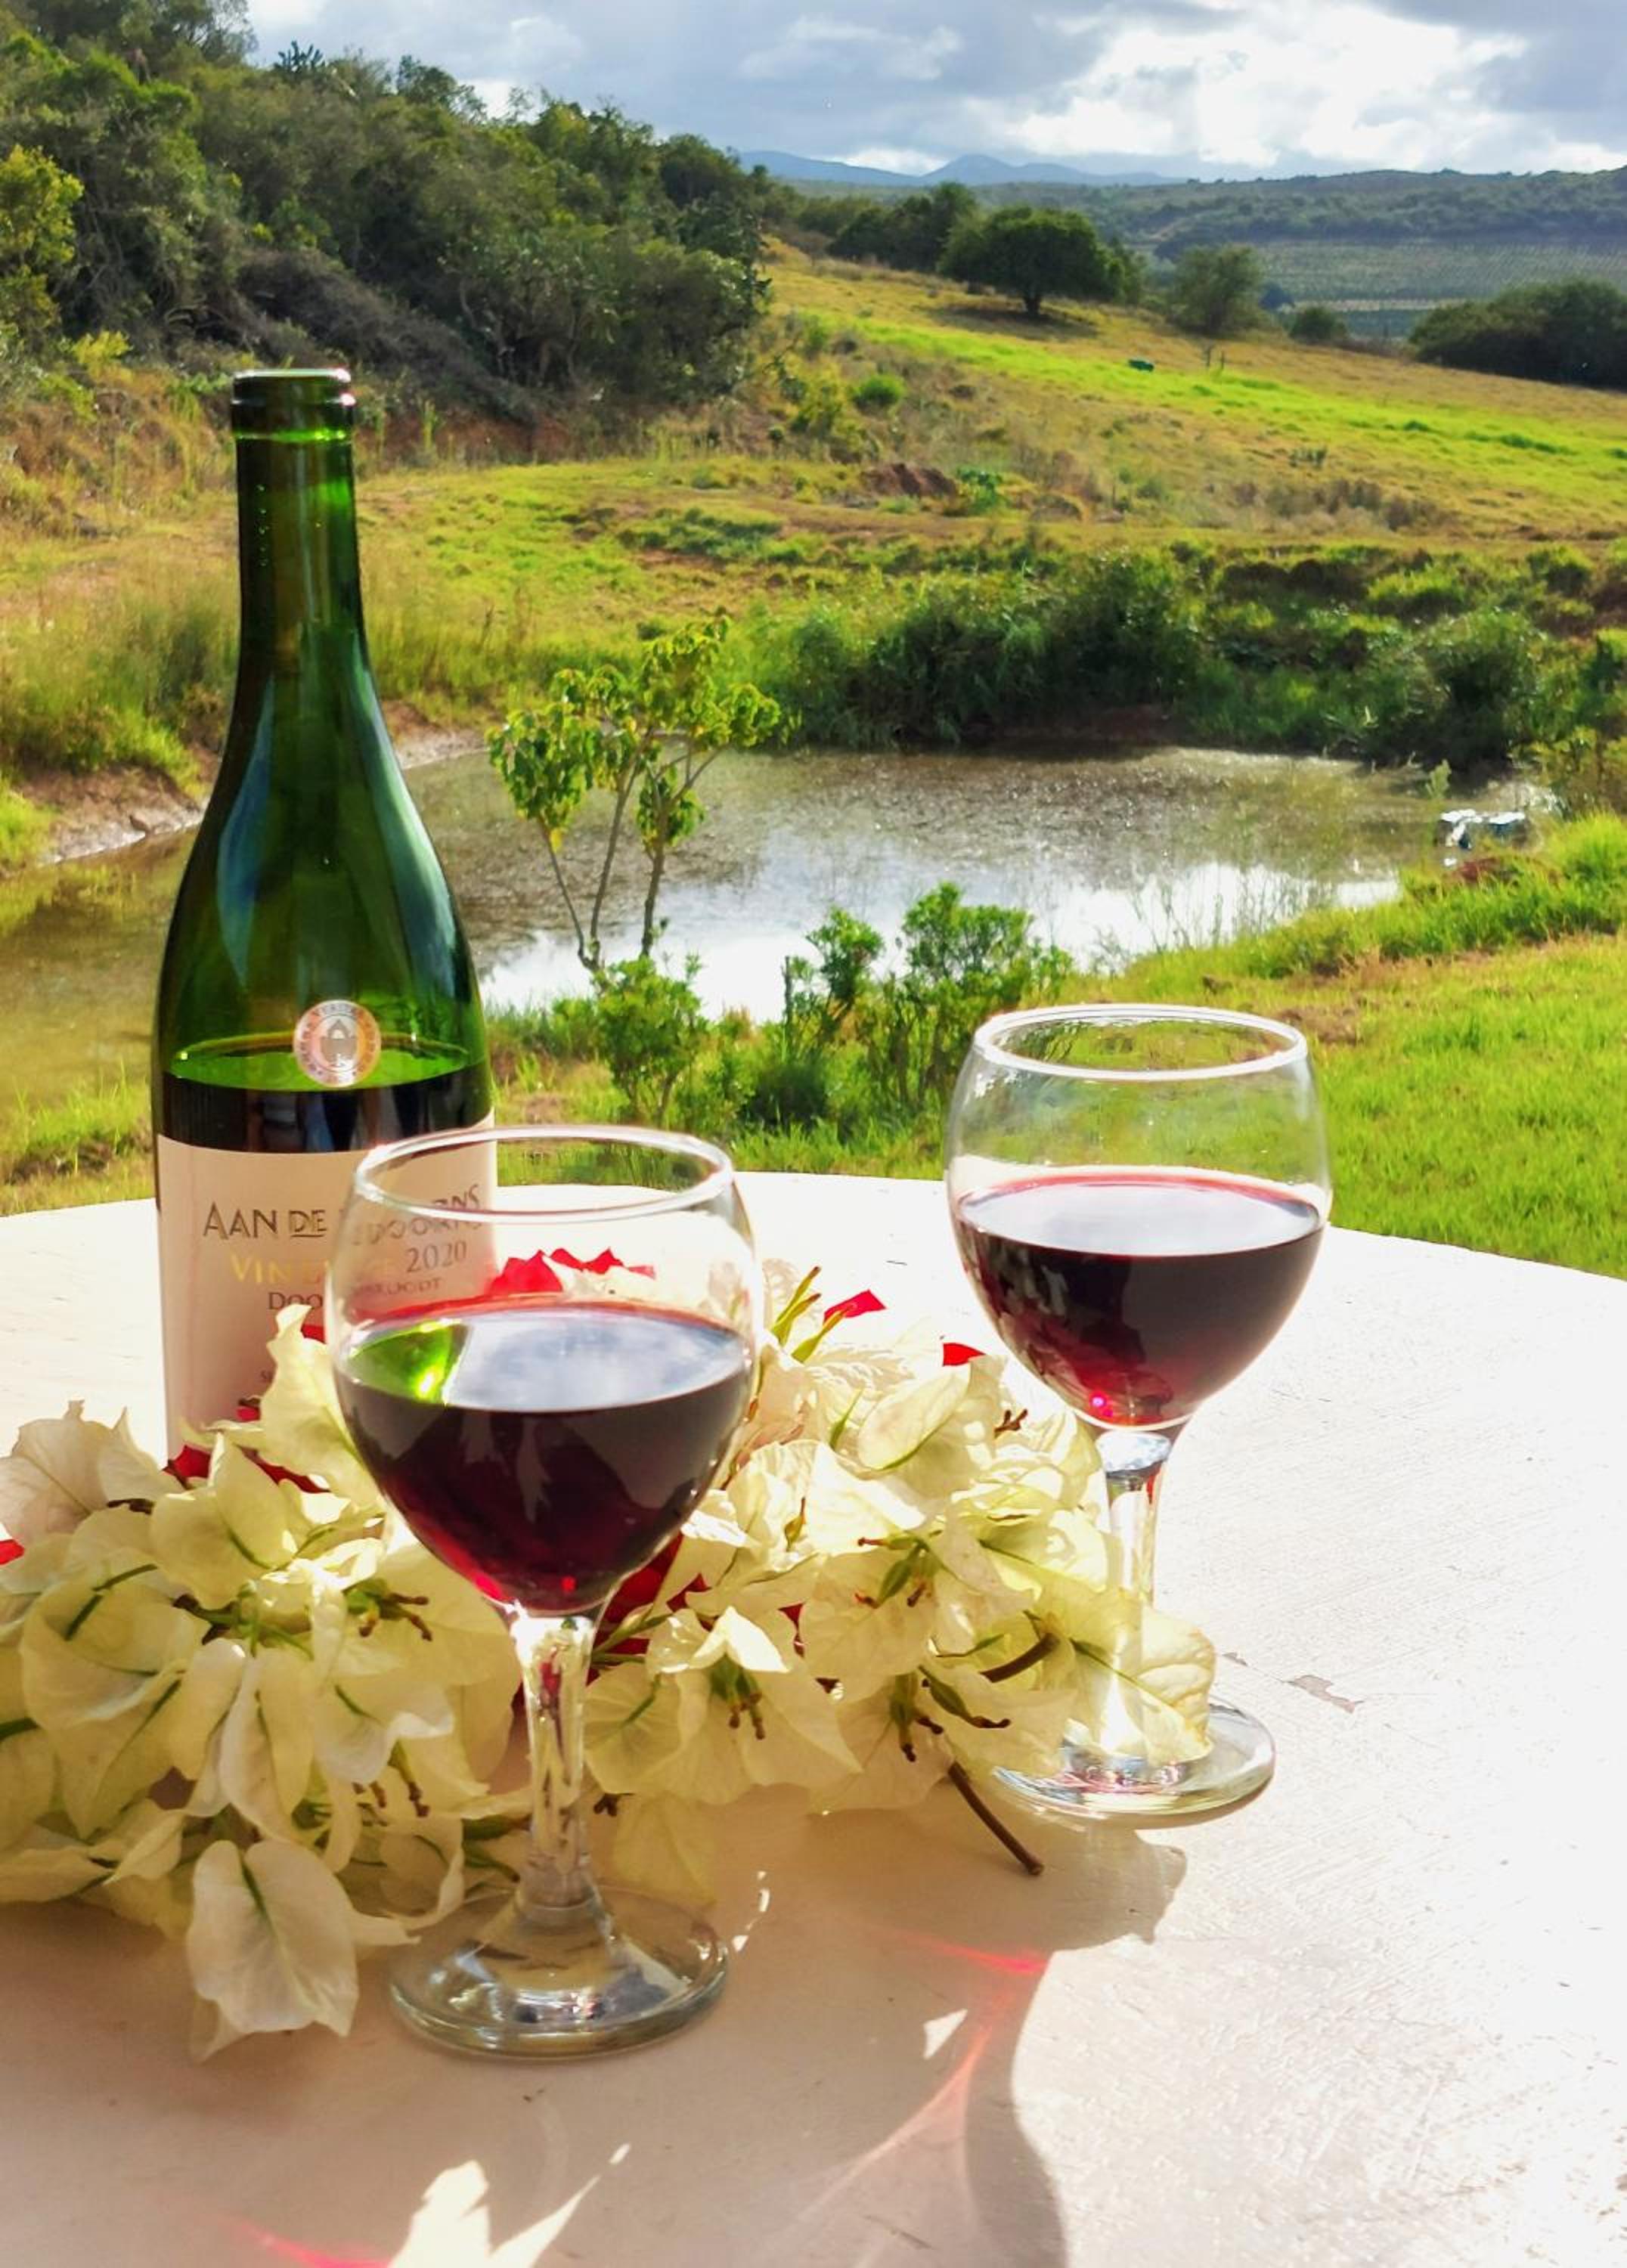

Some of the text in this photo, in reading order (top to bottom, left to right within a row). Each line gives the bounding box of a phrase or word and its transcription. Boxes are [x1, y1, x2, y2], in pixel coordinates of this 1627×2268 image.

[203, 1201, 277, 1240] AAN
[289, 1210, 327, 1238] DE
[406, 1239, 466, 1273] 2020
